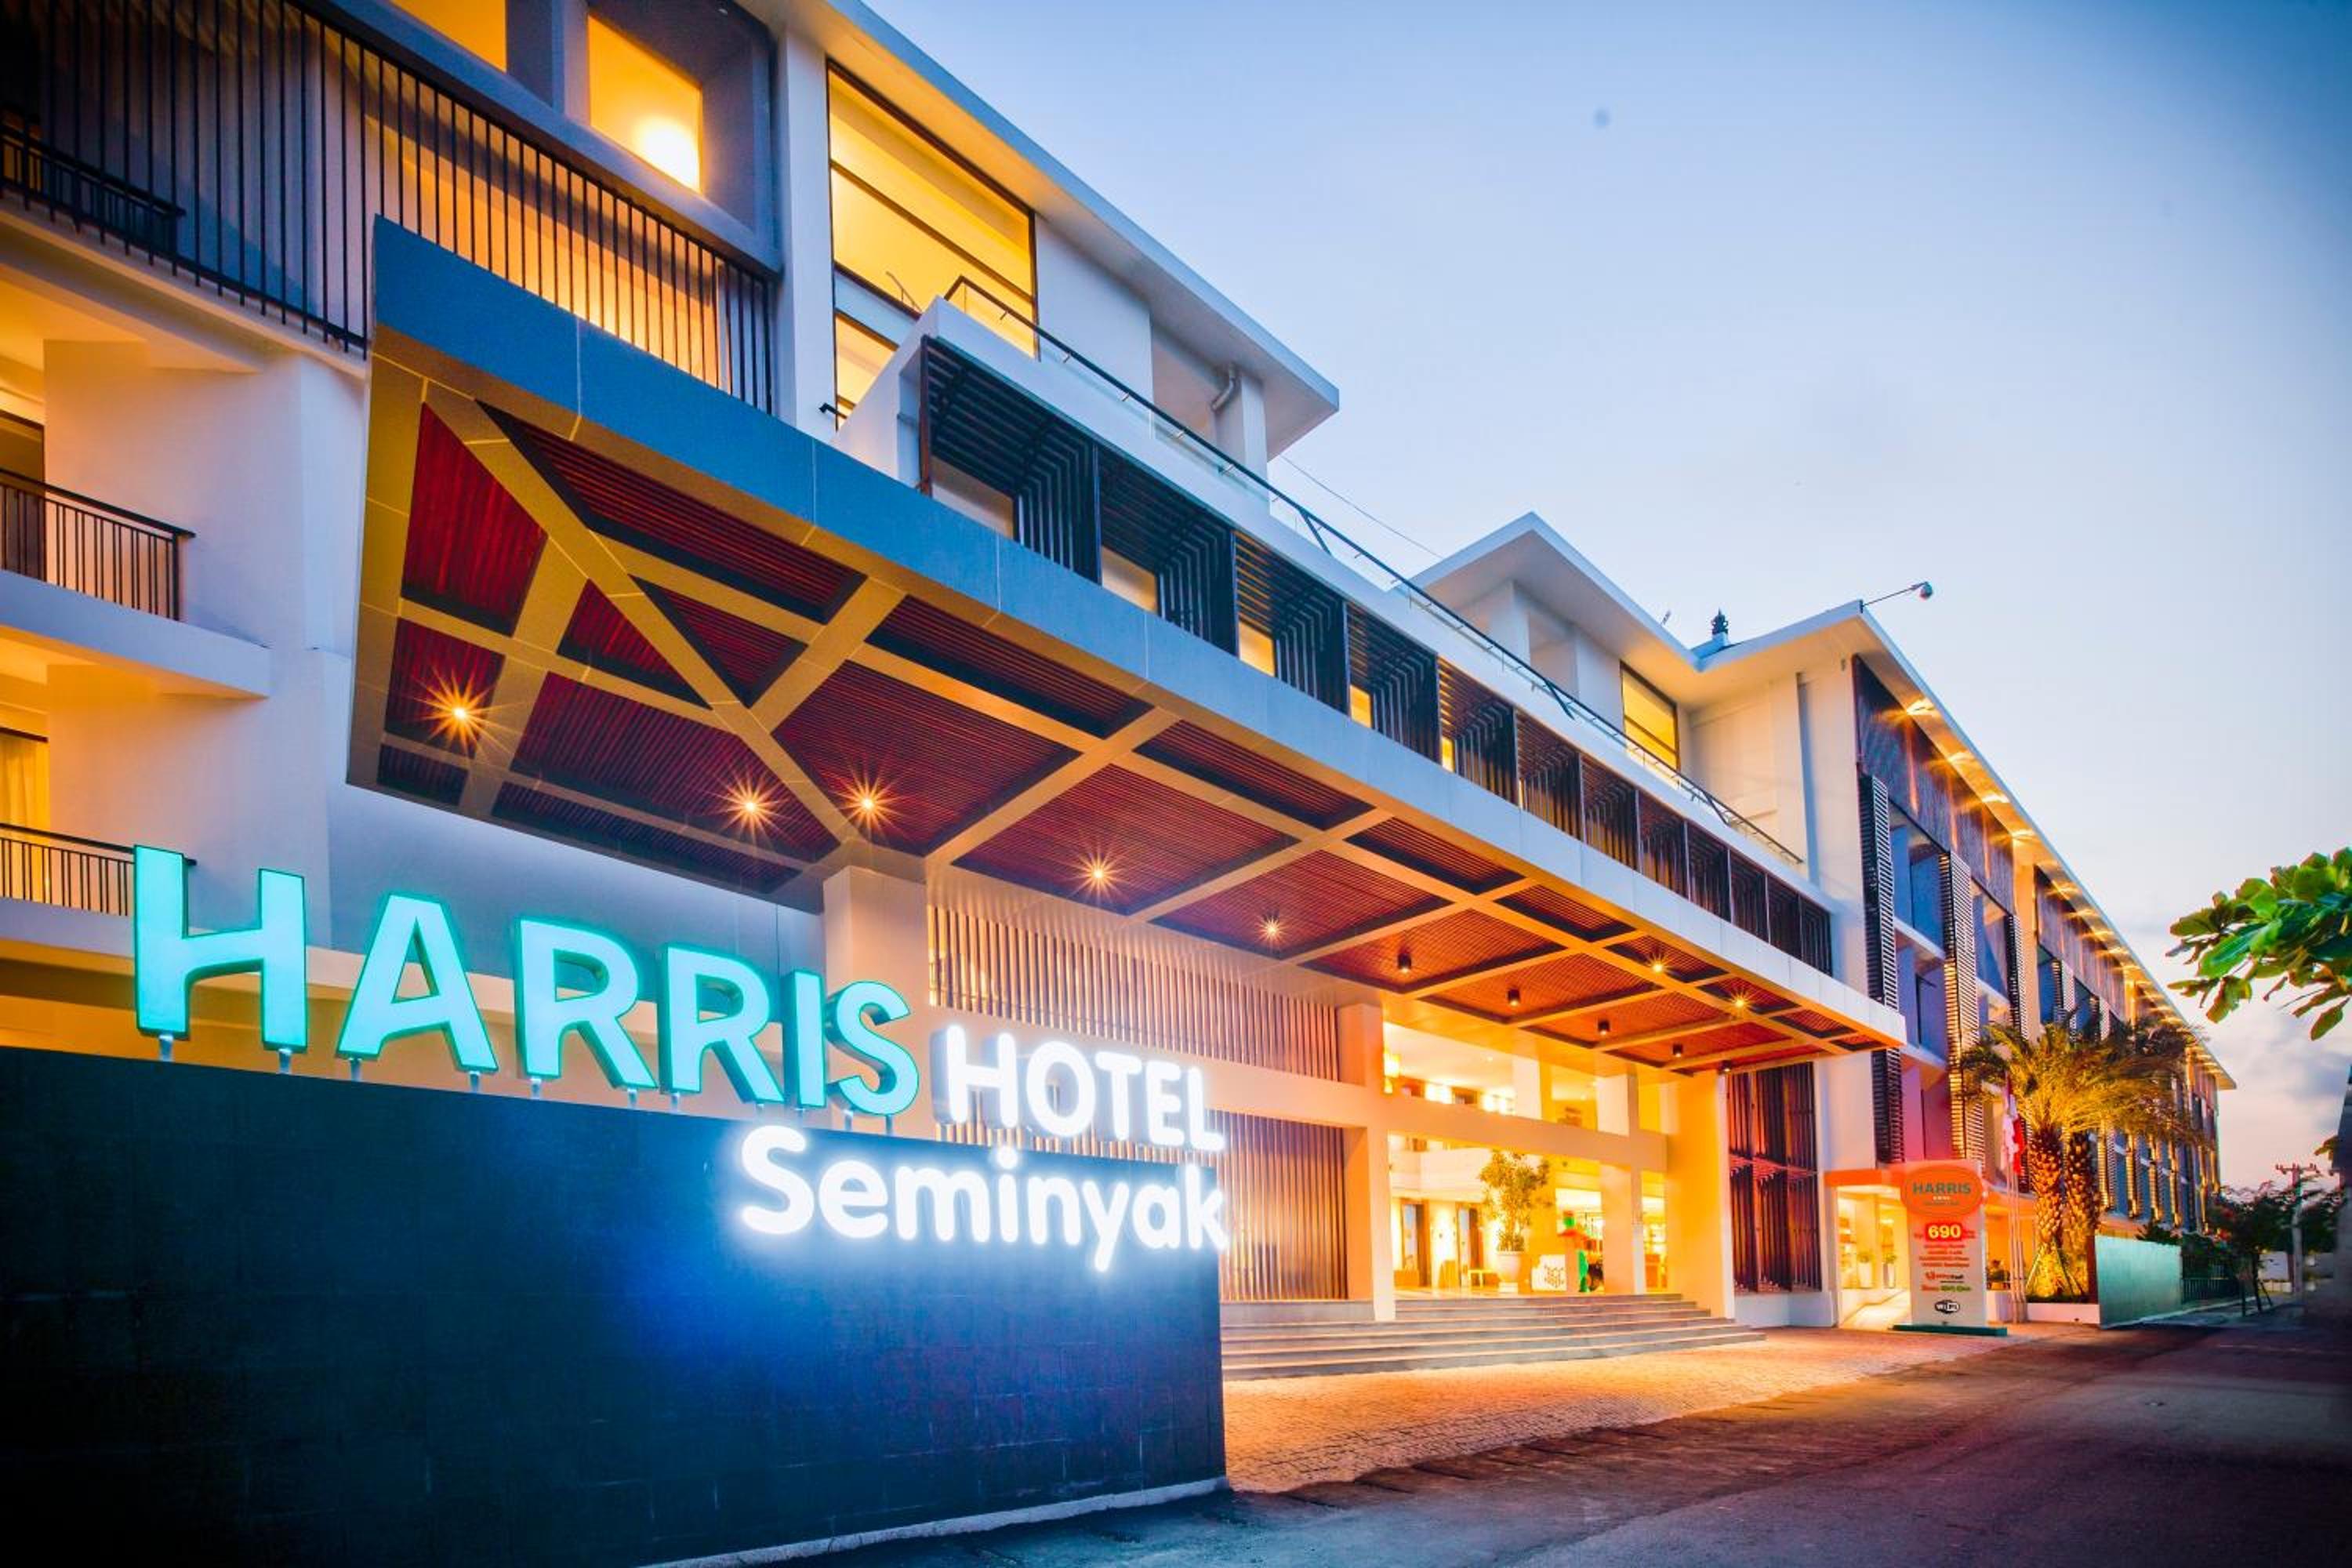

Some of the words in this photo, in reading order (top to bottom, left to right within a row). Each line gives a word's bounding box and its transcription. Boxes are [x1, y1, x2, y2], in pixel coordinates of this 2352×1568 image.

[133, 844, 920, 1116] HARRIS
[933, 1024, 1226, 1152] HOTEL
[738, 1123, 1231, 1274] Seminyak
[1912, 1181, 1971, 1195] HARRIS
[1928, 1225, 1962, 1239] 690
